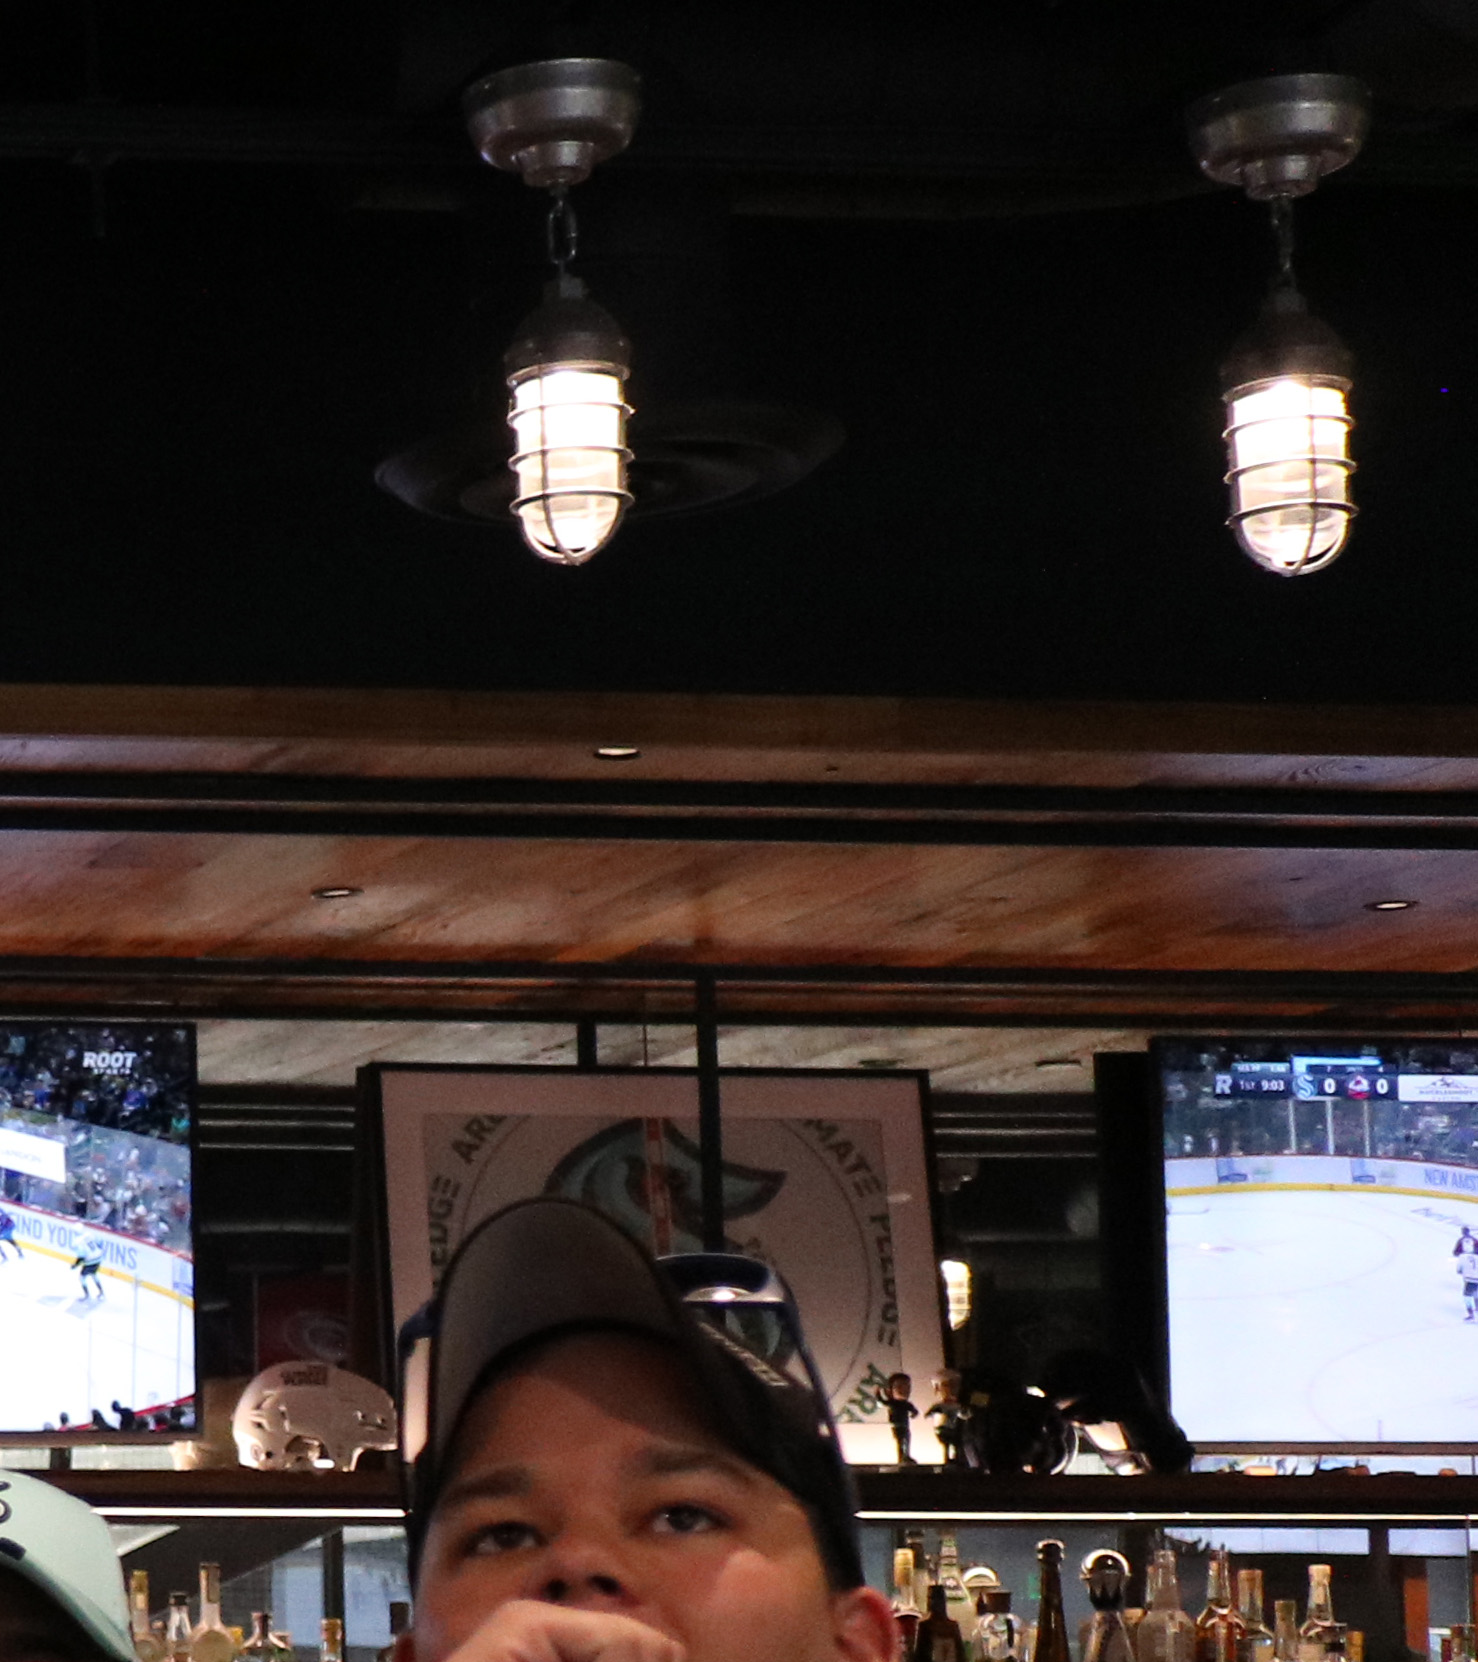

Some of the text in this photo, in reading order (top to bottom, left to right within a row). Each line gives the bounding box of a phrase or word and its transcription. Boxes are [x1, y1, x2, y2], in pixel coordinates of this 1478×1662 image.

[82, 1051, 137, 1069] ROOT
[1260, 1078, 1285, 1092] 9:03
[1424, 1168, 1449, 1188] NEW
[44, 1217, 79, 1248] YOU
